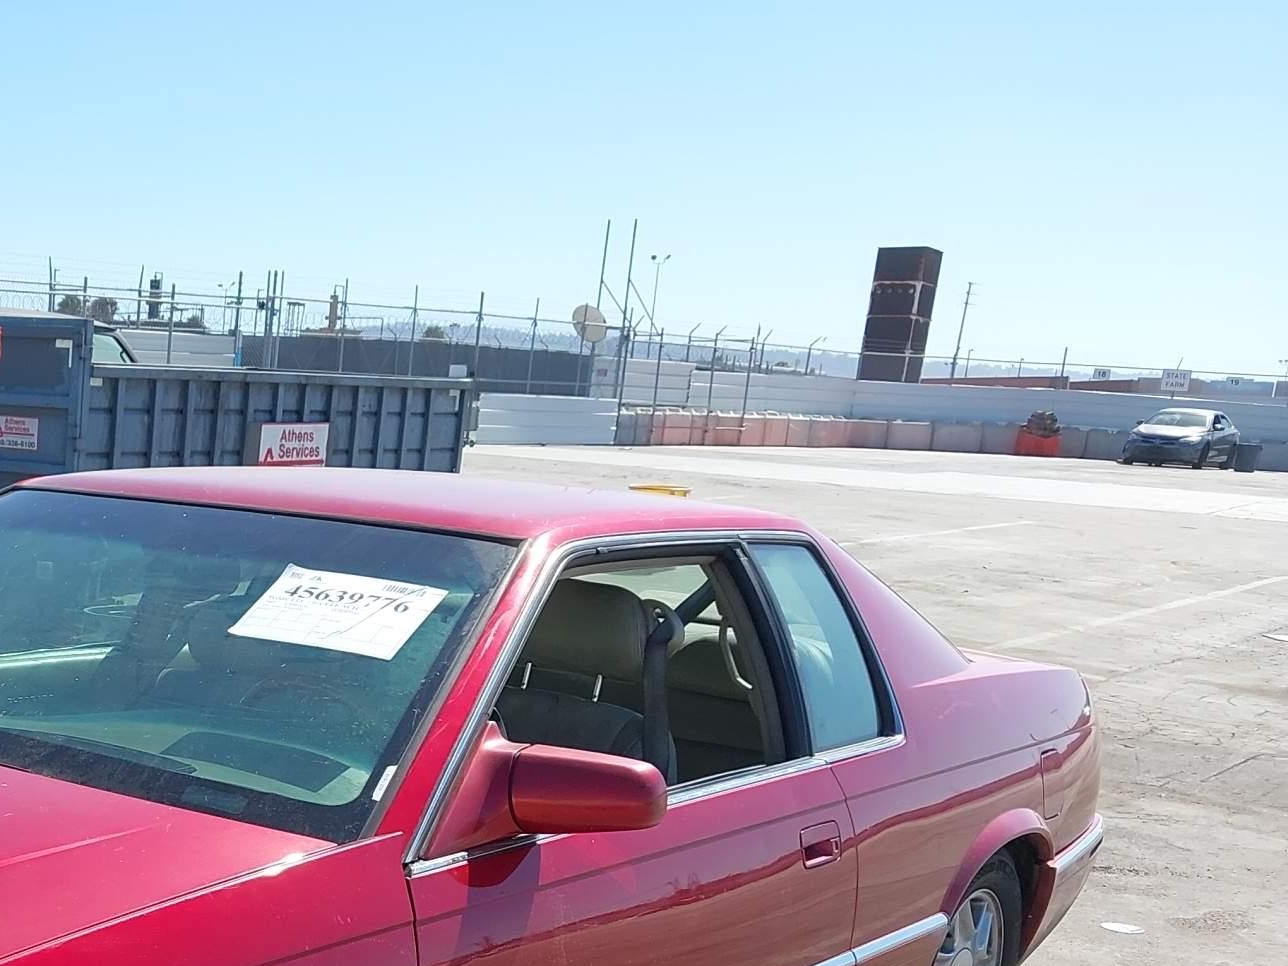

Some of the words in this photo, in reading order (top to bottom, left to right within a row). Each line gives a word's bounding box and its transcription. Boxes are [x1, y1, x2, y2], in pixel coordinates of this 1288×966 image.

[280, 429, 315, 443] Athens
[278, 444, 320, 459] Services
[284, 585, 412, 613] 45639776
